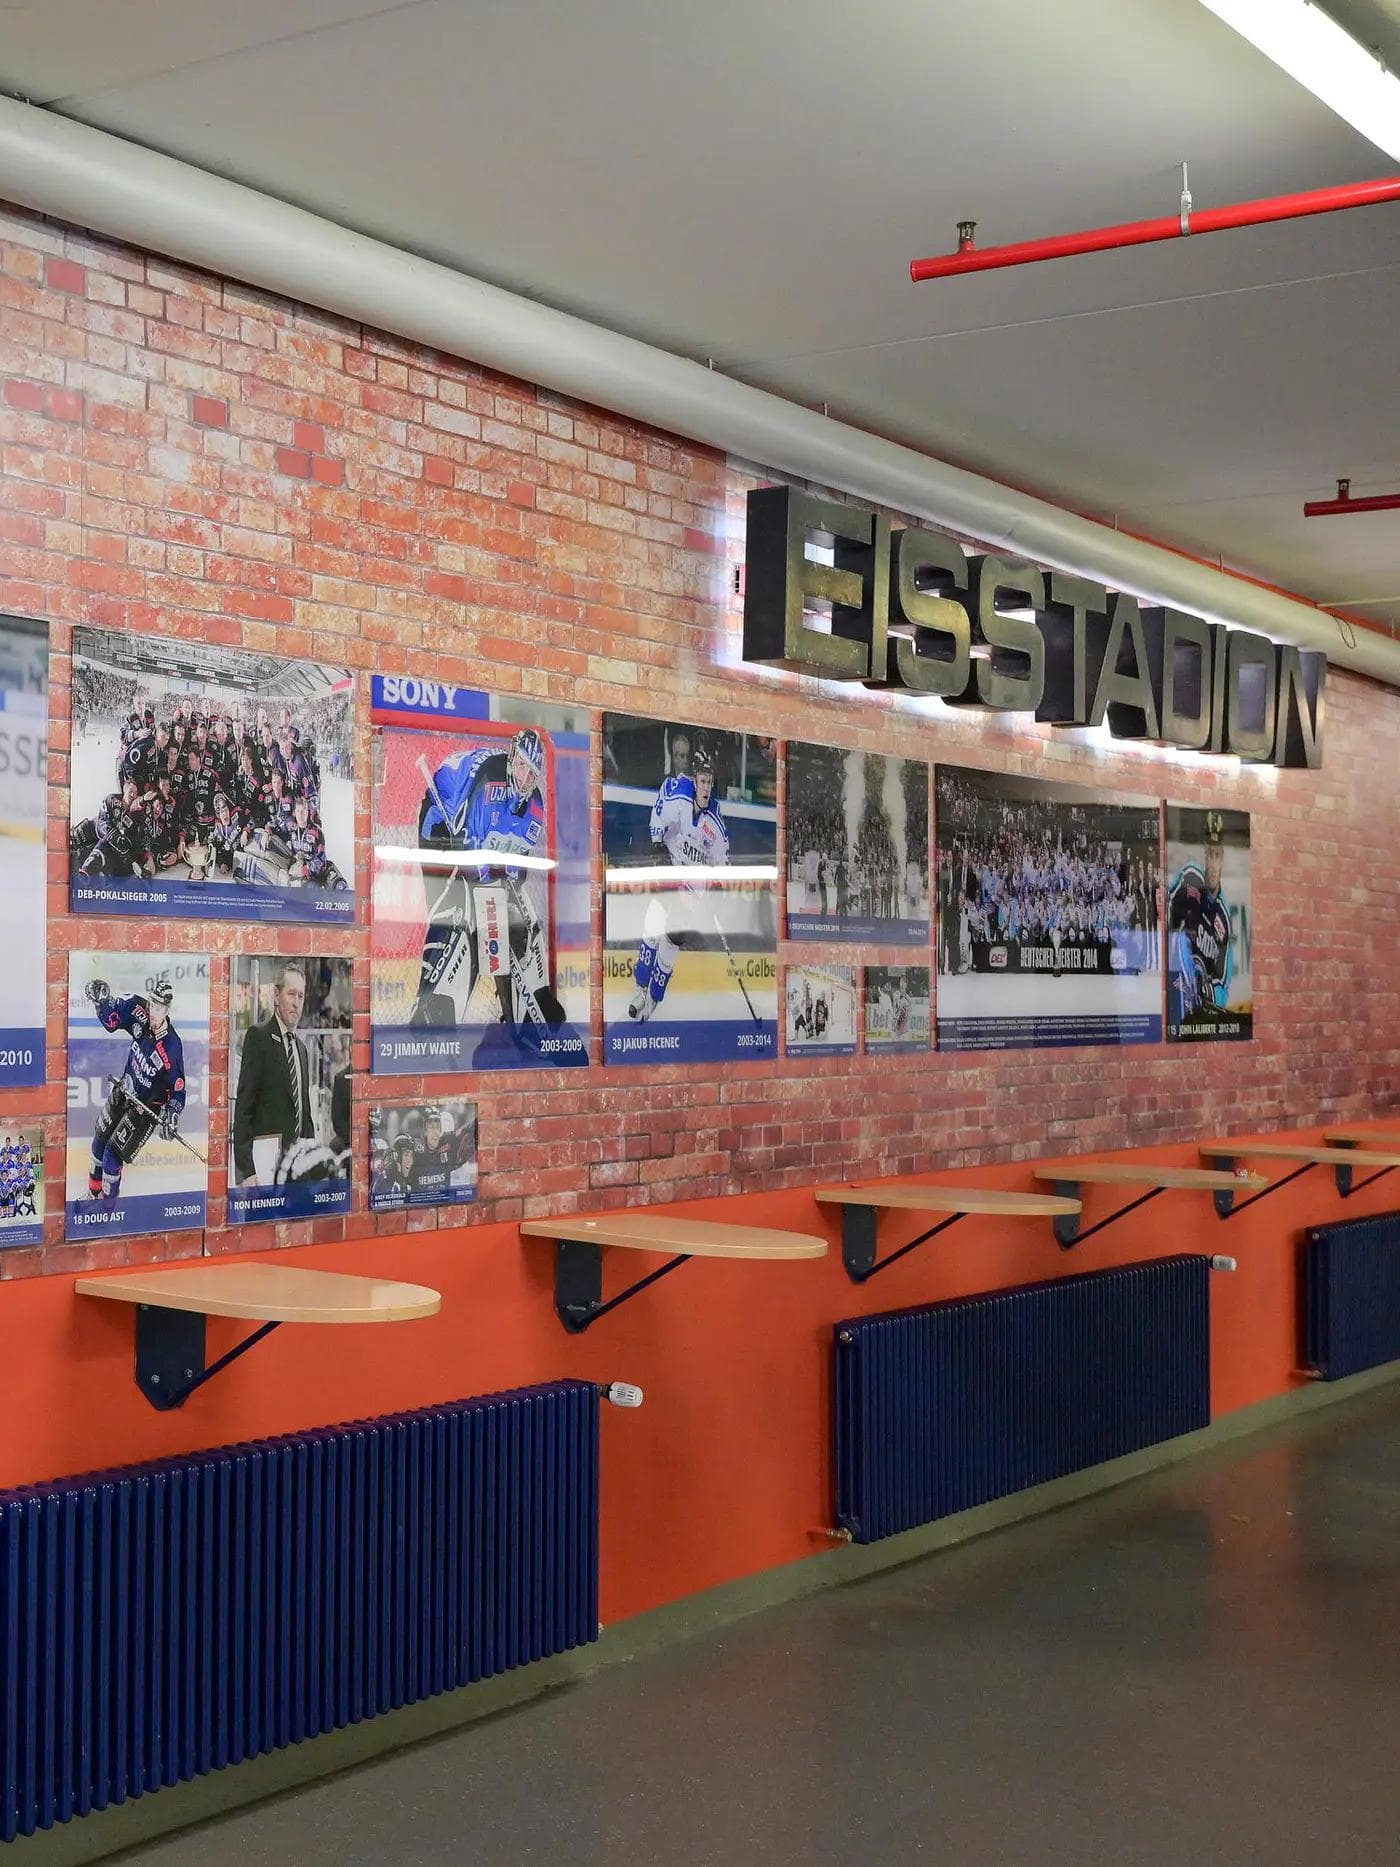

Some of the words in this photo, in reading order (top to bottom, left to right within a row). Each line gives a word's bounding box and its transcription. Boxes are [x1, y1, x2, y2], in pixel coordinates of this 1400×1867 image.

[743, 486, 1327, 769] EISSTADION
[383, 677, 457, 710] SONY
[77, 888, 148, 902] DEB-POKALSIEGER
[149, 892, 167, 903] 2005
[315, 901, 350, 912] 22.02.2005
[1020, 946, 1054, 969] DEUTSCHER
[1082, 948, 1098, 969] 2014
[380, 1043, 392, 1056] 29
[393, 1043, 427, 1059] JIMMY
[428, 1042, 460, 1055] WAITE
[540, 1039, 582, 1052] 2003-2009
[613, 1039, 622, 1049] 38
[623, 1038, 648, 1052] JAKUB
[649, 1036, 680, 1048] FICENEC
[234, 1199, 251, 1210] RON
[252, 1197, 286, 1209] KENNEDY
[314, 1192, 347, 1203] 2003-2007
[73, 1215, 83, 1225] 18
[84, 1213, 109, 1224] DOUG
[110, 1211, 126, 1222] AST
[164, 1204, 201, 1217] 2003-2009
